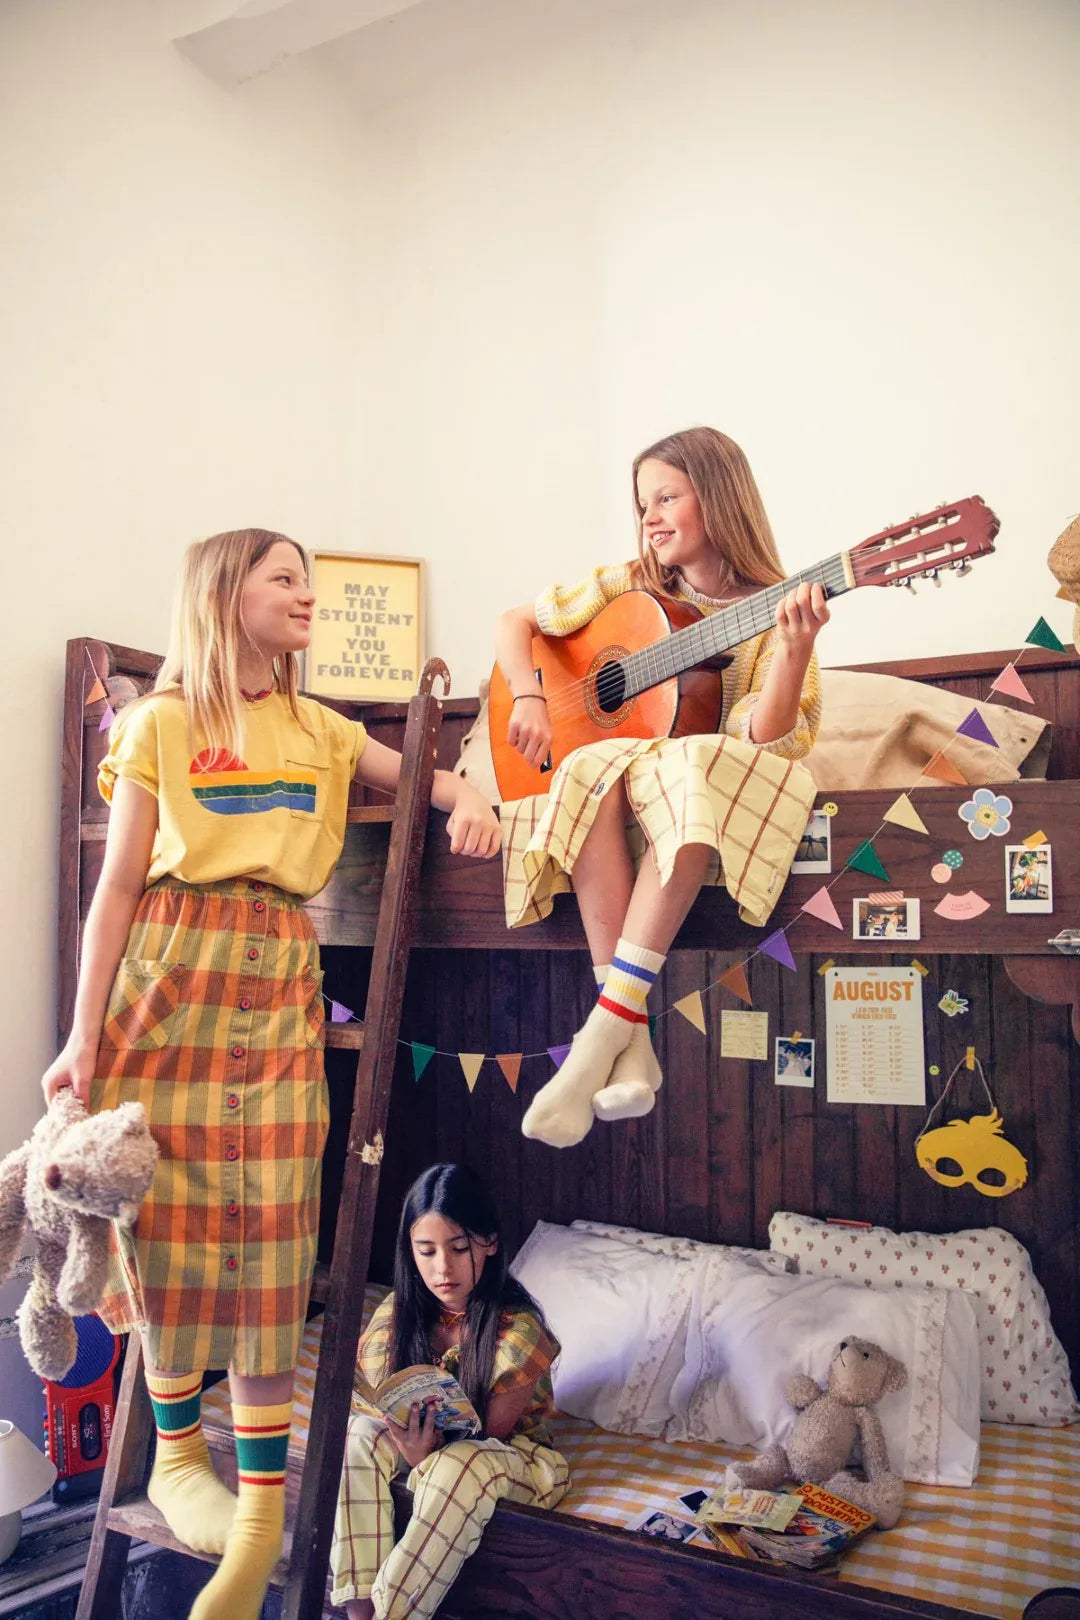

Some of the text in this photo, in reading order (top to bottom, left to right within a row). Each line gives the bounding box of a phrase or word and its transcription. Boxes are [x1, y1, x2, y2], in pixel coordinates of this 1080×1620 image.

[344, 583, 390, 597] MAY
[345, 597, 387, 611] THE
[318, 608, 415, 626] STUDENT
[355, 625, 377, 637] IN
[345, 638, 386, 651] YOU
[342, 652, 391, 666] LIVE
[317, 664, 414, 681] FOREVER
[832, 981, 914, 1001] AUGUST
[104, 1404, 112, 1423] Sony
[802, 1485, 813, 1494] O
